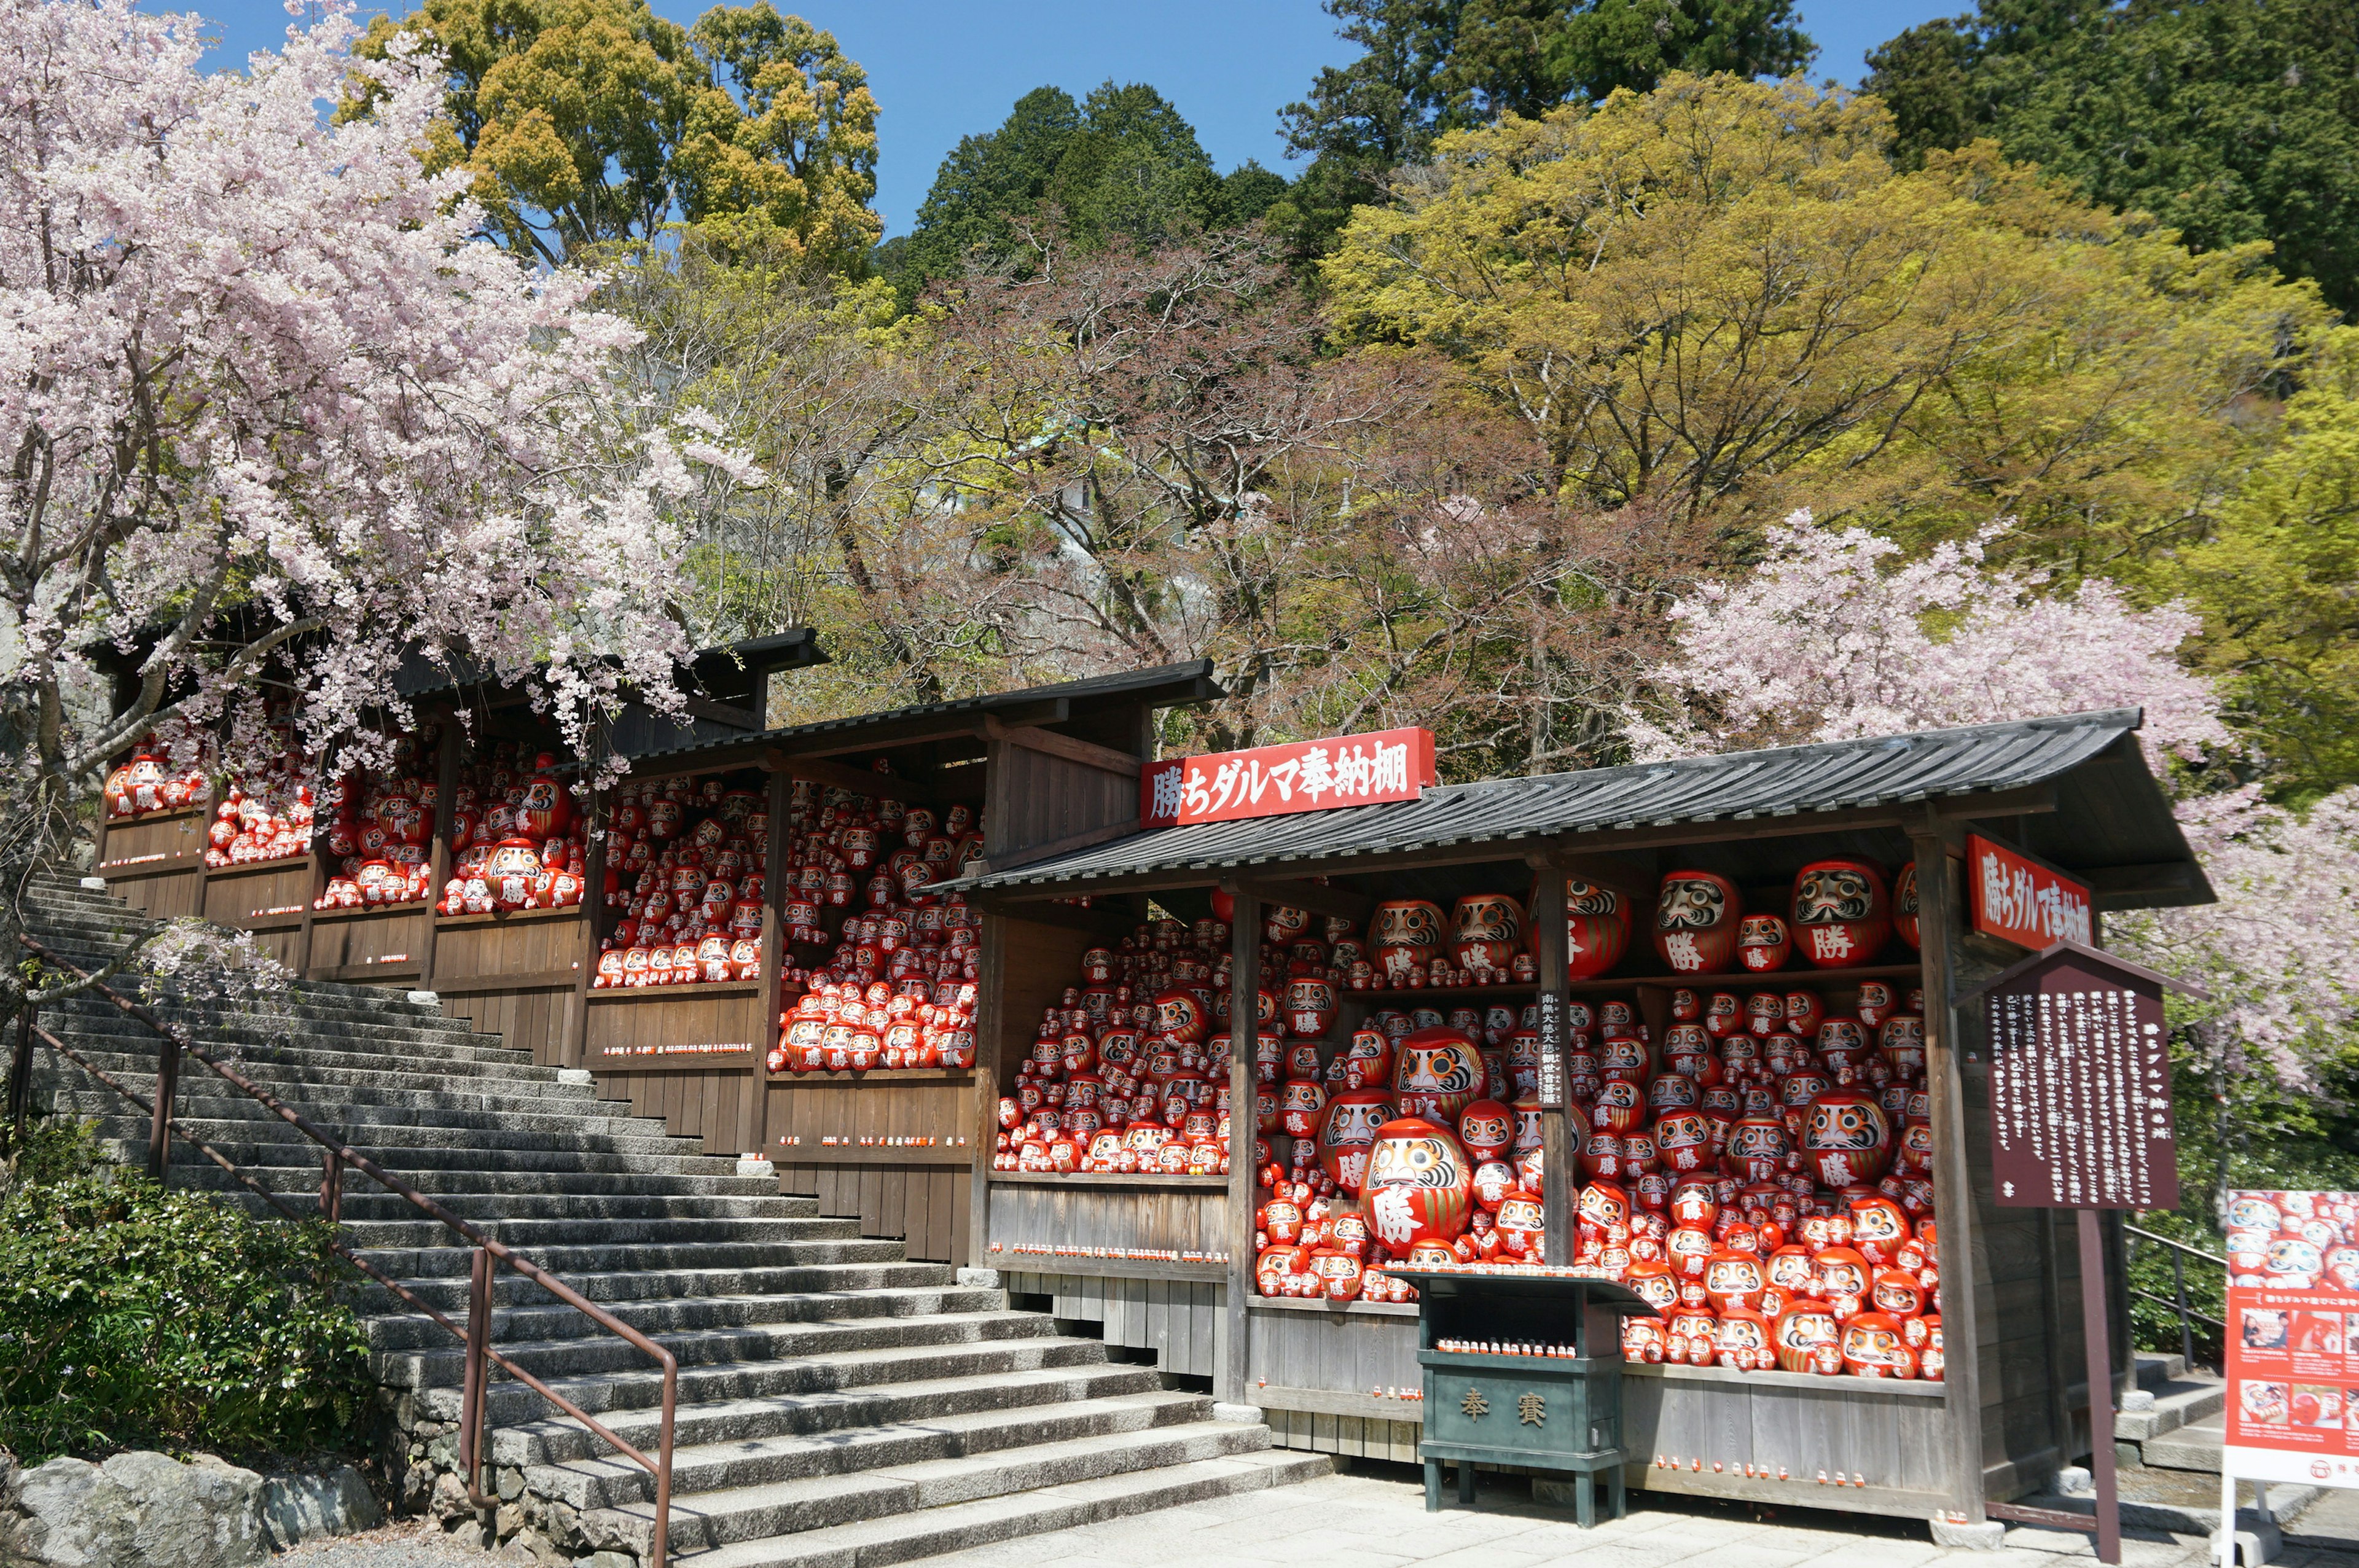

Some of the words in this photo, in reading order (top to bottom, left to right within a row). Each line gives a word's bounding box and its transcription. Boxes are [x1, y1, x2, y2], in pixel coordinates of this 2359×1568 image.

[1150, 741, 1407, 821] 勝ちダルマ奉納棚
[136, 784, 157, 809] 勝
[652, 821, 666, 835] 勝
[946, 822, 955, 834] 勝
[907, 832, 921, 846] 勝
[851, 851, 867, 865] 勝
[367, 884, 380, 900] 勝
[386, 887, 397, 900] 勝
[501, 878, 528, 903] 勝
[832, 892, 844, 903] 勝
[874, 891, 887, 904] 勝
[1983, 852, 2091, 946] 勝ちダルマ奉納棚
[1268, 924, 1283, 942] 勝
[882, 937, 894, 950] 勝
[1812, 926, 1854, 959] 勝
[952, 946, 962, 959] 勝
[1461, 943, 1495, 972] 勝
[1665, 932, 1704, 970] 勝
[1747, 948, 1768, 967] 勝
[894, 965, 906, 977] 勝
[964, 965, 975, 978] 勝
[1092, 967, 1108, 980] 勝
[1214, 973, 1225, 986] 勝
[1295, 1012, 1320, 1033] 勝
[1708, 1015, 1721, 1031] 勝
[1860, 1008, 1877, 1024] 勝
[1603, 1024, 1616, 1037] 勝
[1753, 1016, 1770, 1034] 勝
[1788, 1020, 1802, 1034] 勝
[1164, 1033, 1182, 1047] 勝
[952, 1050, 963, 1064] 勝
[1541, 994, 1555, 1104] 南無大慈大悲観世音菩薩
[805, 1050, 822, 1065] 勝
[832, 1050, 848, 1066] 勝
[854, 1051, 867, 1065] 勝
[1065, 1056, 1078, 1069] 勝
[1183, 1056, 1193, 1067] 勝
[1676, 1056, 1696, 1074] 勝
[1828, 1051, 1851, 1072] 勝
[1041, 1064, 1054, 1075] 勝
[1516, 1069, 1538, 1090] 勝
[1286, 1112, 1308, 1132] 勝
[1595, 1106, 1612, 1126] 勝
[1075, 1131, 1089, 1145] 勝
[1294, 1156, 1305, 1166] 勝
[1598, 1155, 1617, 1175] 勝
[1676, 1148, 1699, 1169] 勝
[1627, 1161, 1644, 1177] 勝
[1820, 1152, 1858, 1186] 勝
[1525, 1172, 1539, 1190] 勝
[1482, 1183, 1504, 1201] 勝
[1651, 1192, 1662, 1204] 勝
[1372, 1185, 1424, 1243] 勝
[1683, 1200, 1704, 1219] 勝
[1276, 1223, 1291, 1239] 勝
[1508, 1230, 1528, 1250] 勝
[1861, 1242, 1884, 1263] 勝
[1685, 1256, 1704, 1274] 勝
[1330, 1279, 1345, 1295] 勝
[1724, 1293, 1745, 1309] 勝
[1719, 1351, 1739, 1368] 勝
[1460, 1387, 1489, 1422] 奉
[1518, 1392, 1546, 1428] 賽
